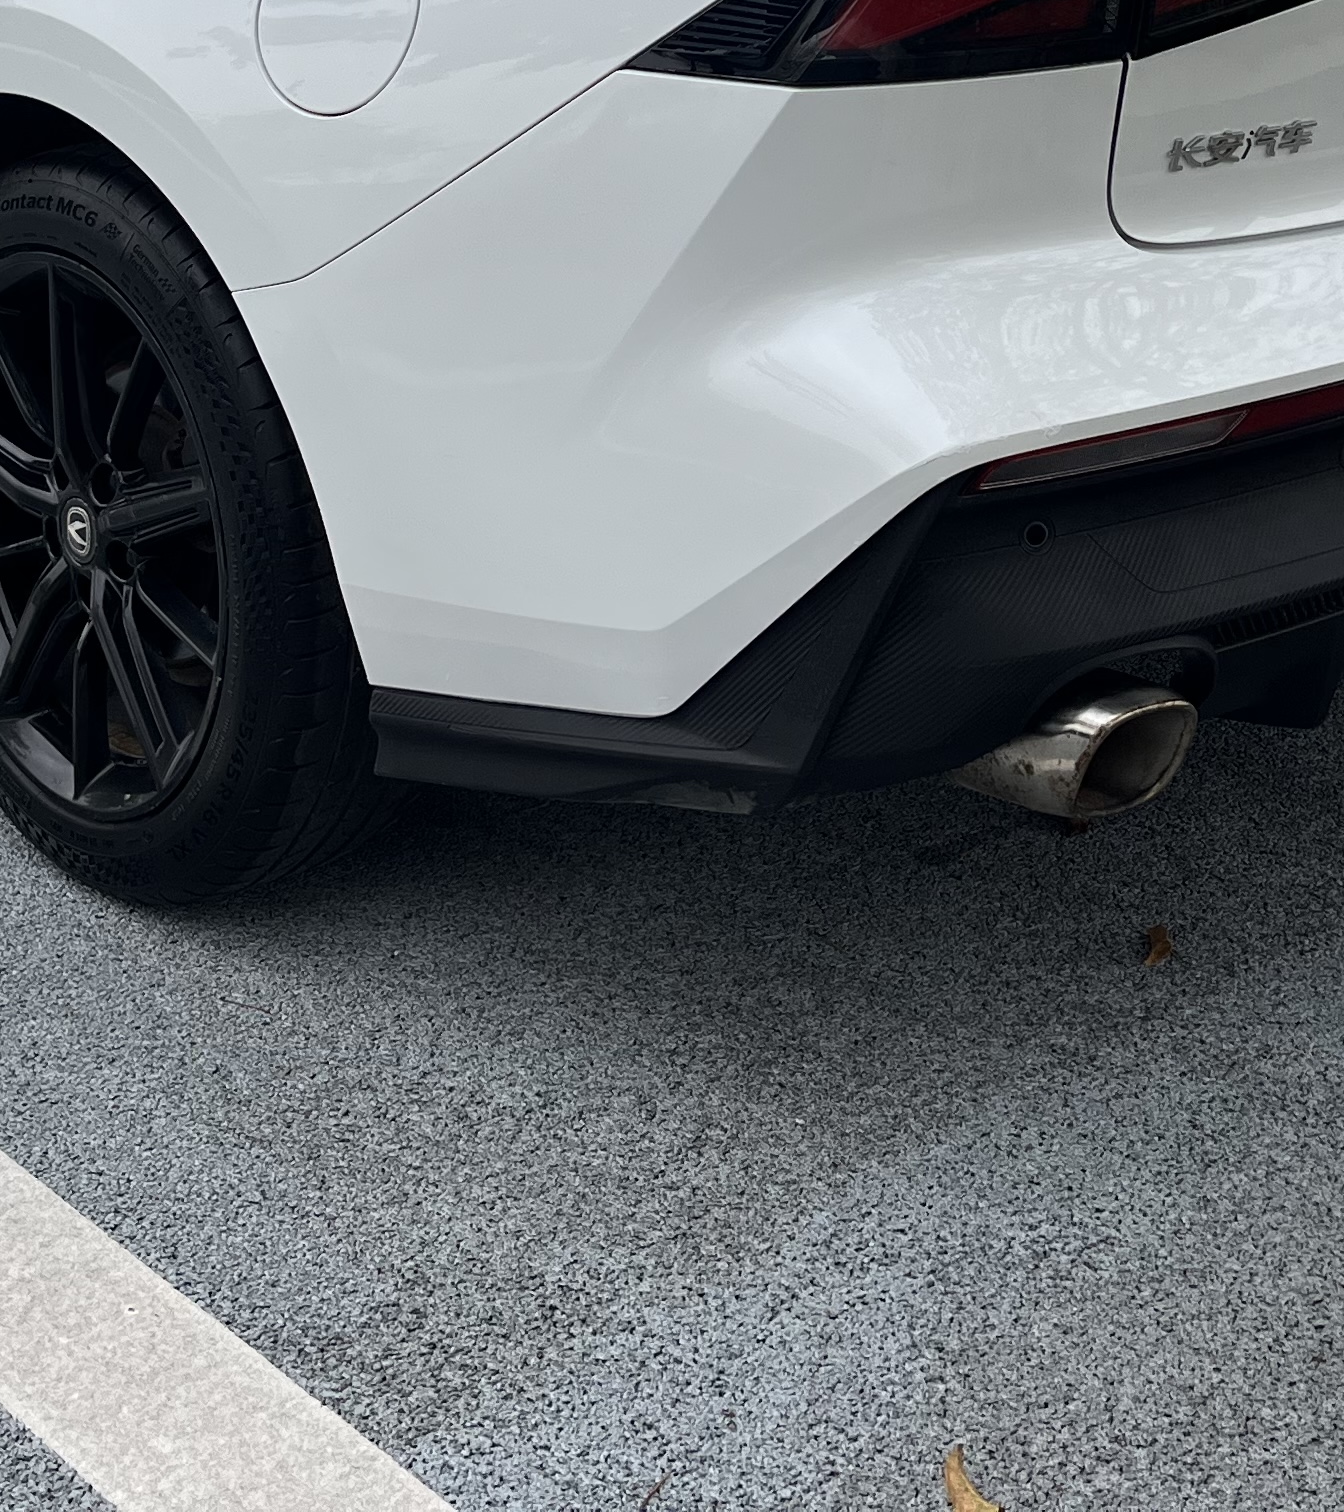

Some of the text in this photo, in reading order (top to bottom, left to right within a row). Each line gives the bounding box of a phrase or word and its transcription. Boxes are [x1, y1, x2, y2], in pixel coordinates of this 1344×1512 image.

[1166, 119, 1318, 172] 长安汽车
[55, 195, 100, 229] MC6
[132, 243, 160, 279] German
